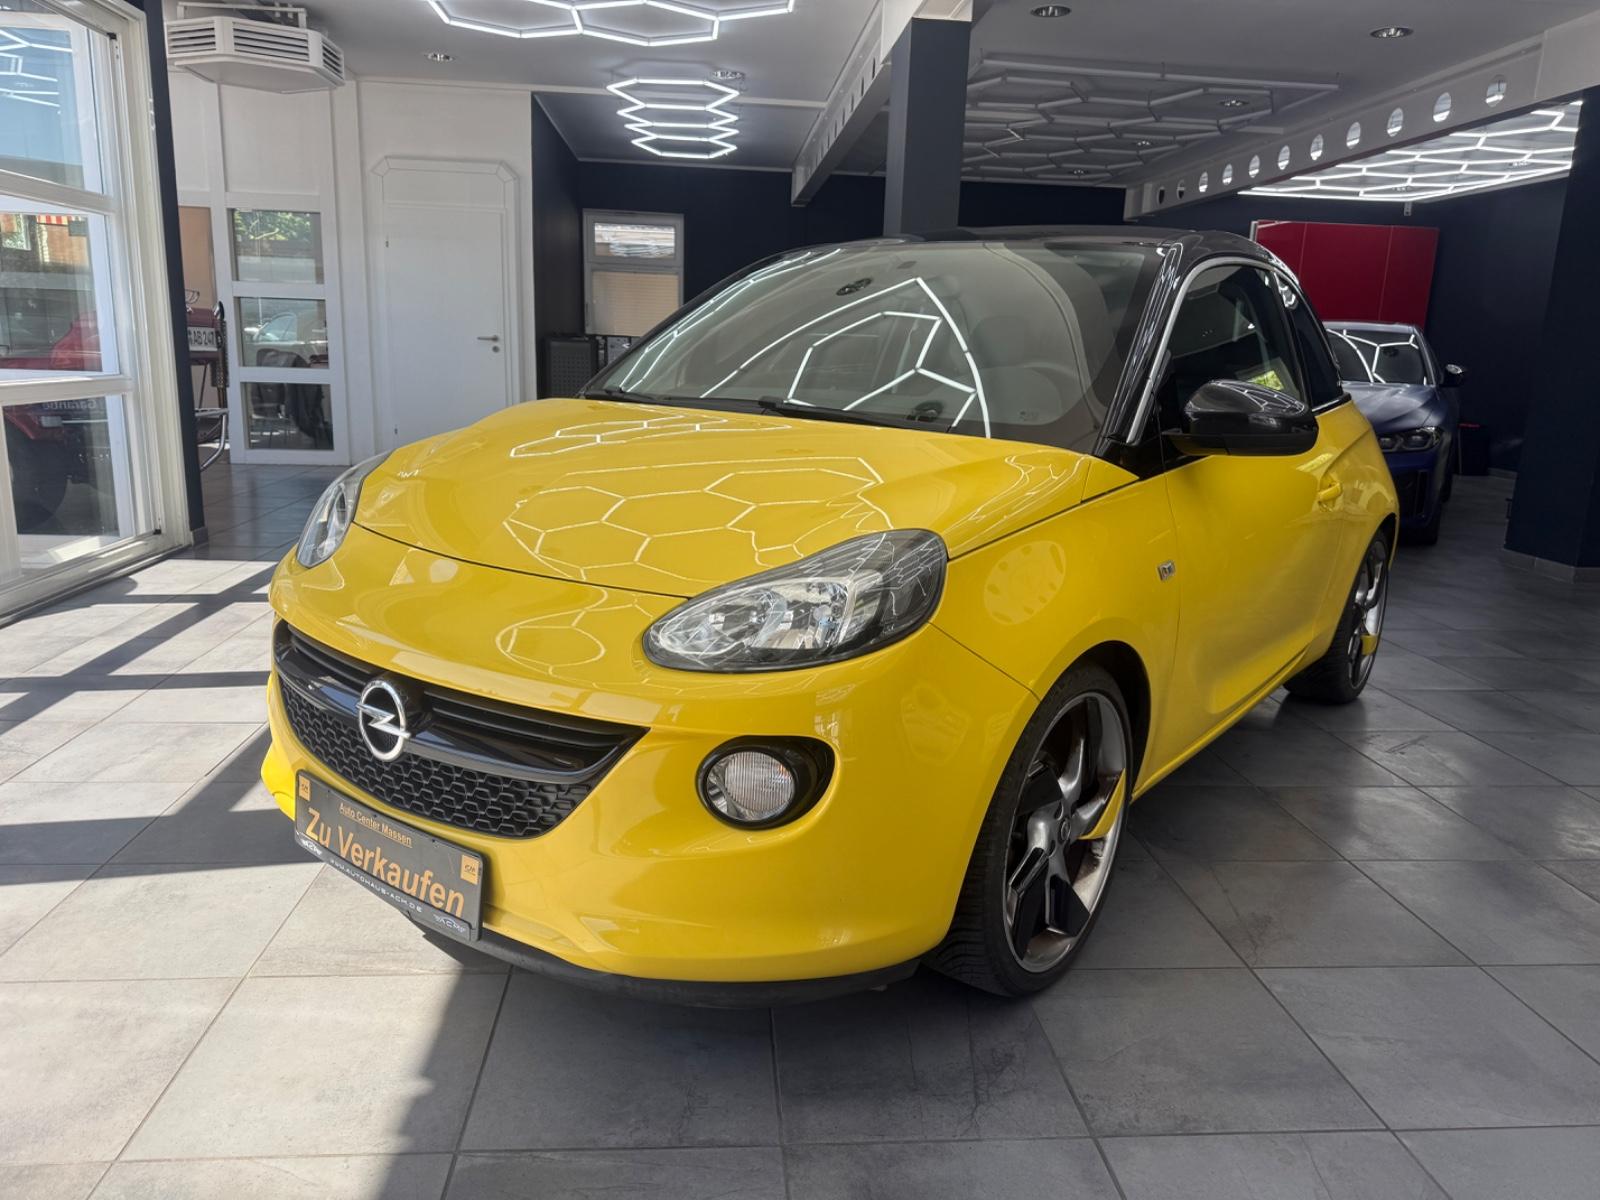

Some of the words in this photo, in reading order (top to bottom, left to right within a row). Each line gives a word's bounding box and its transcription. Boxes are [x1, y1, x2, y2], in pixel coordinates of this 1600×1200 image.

[306, 807, 331, 848] Zu
[338, 825, 465, 919] Verkaufen
[339, 802, 356, 818] Auto
[356, 810, 380, 831] Center
[381, 822, 412, 846] Massen
